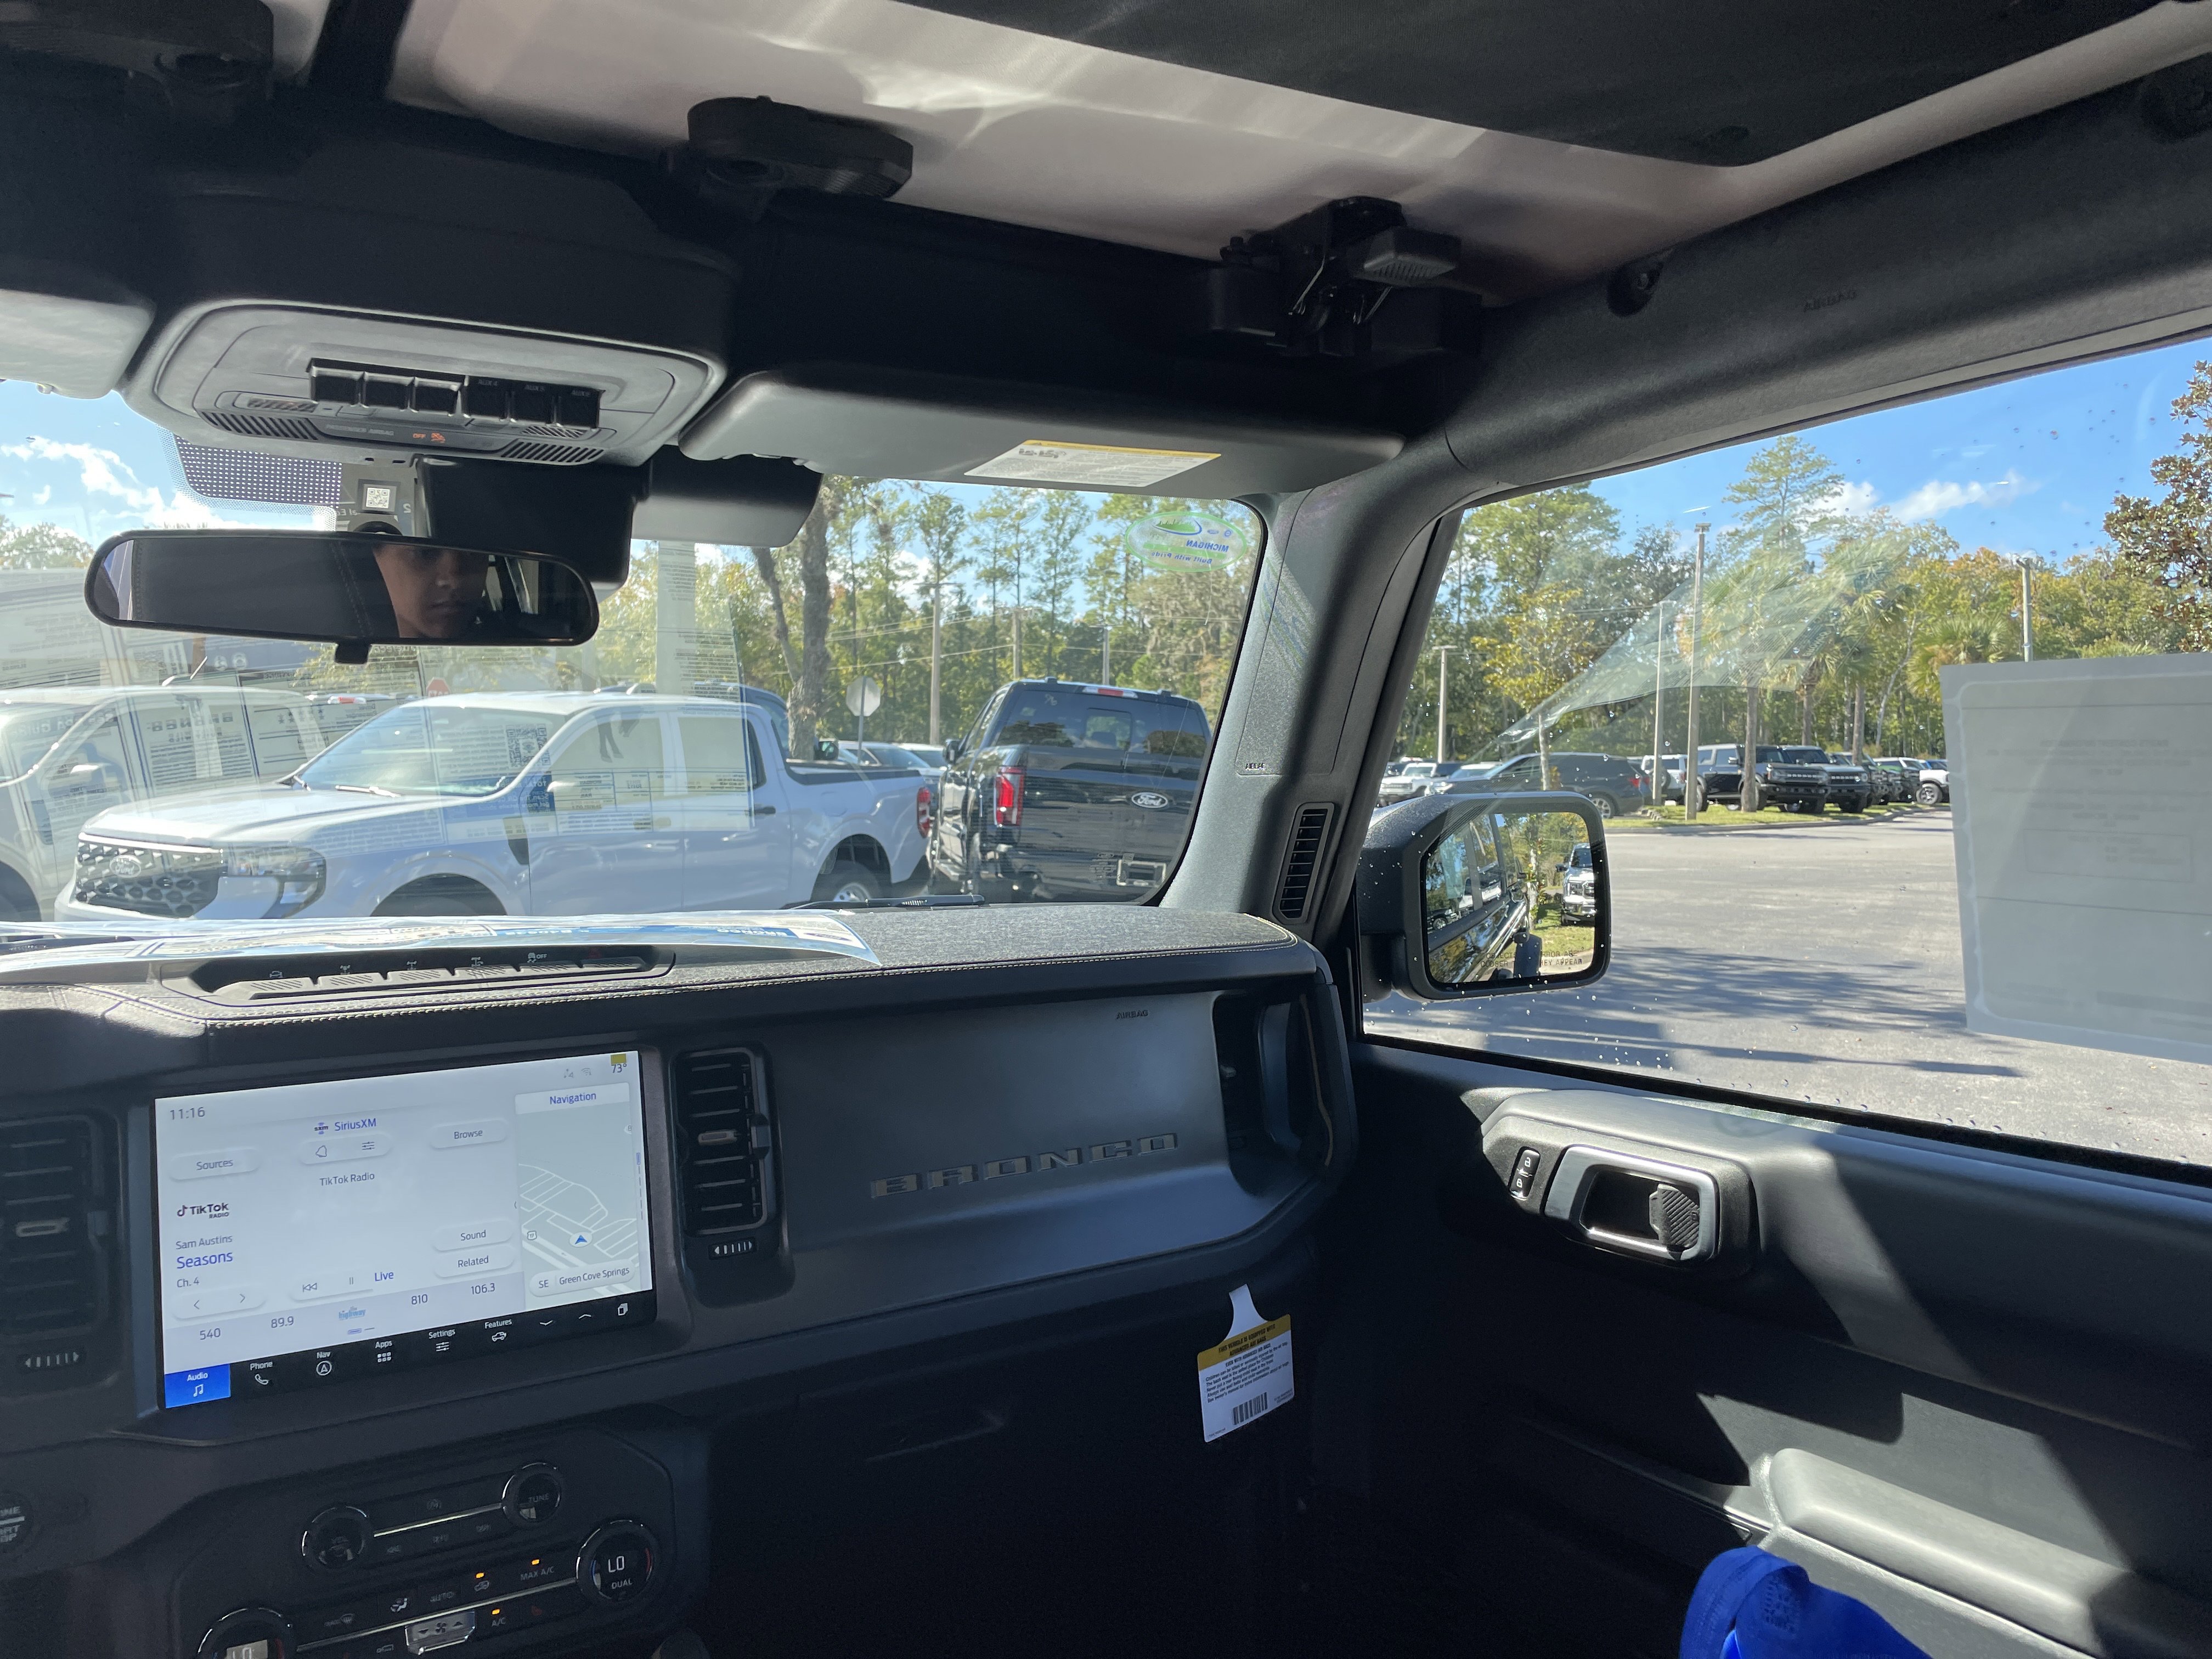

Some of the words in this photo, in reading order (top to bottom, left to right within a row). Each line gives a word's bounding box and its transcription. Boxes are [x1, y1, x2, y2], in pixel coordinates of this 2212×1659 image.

[1116, 1009, 1149, 1020] AIRBAG
[549, 1092, 597, 1105] Navigation
[170, 1107, 206, 1120] 11:16
[334, 1118, 376, 1131] SiriusXM
[454, 1129, 483, 1139] Browse
[196, 1158, 234, 1171] Sources
[871, 1132, 1178, 1199] BRONCO
[319, 1175, 348, 1186] TikTok
[350, 1172, 375, 1183] Radio
[190, 1202, 229, 1215] TikTok
[176, 1240, 197, 1250] Sam
[198, 1234, 233, 1247] Austins
[460, 1229, 487, 1242] Sound
[176, 1251, 233, 1269] Seasons
[457, 1255, 489, 1268] Related
[177, 1278, 192, 1288] Ch.
[193, 1277, 200, 1286] 4
[374, 1271, 394, 1282] Live
[538, 1279, 549, 1289] SE
[558, 1273, 582, 1285] Green
[583, 1271, 601, 1283] Cove
[602, 1266, 630, 1279] Springs
[471, 1283, 496, 1296] 106.3
[411, 1294, 428, 1306] 810
[338, 1308, 366, 1321] highway
[270, 1316, 295, 1329] 89.9
[484, 1318, 513, 1329] Features
[199, 1328, 221, 1341] 540
[428, 1328, 456, 1340] Settings
[375, 1339, 393, 1349] Apps
[317, 1350, 331, 1359] Nav
[250, 1360, 273, 1370] Phone
[187, 1372, 208, 1382] Audio
[528, 1493, 551, 1504] TUNE
[607, 1554, 626, 1574] LO
[520, 1570, 539, 1581] MAX
[540, 1565, 555, 1576] A/C
[611, 1577, 634, 1590] DUAL
[491, 1616, 507, 1628] A/C
